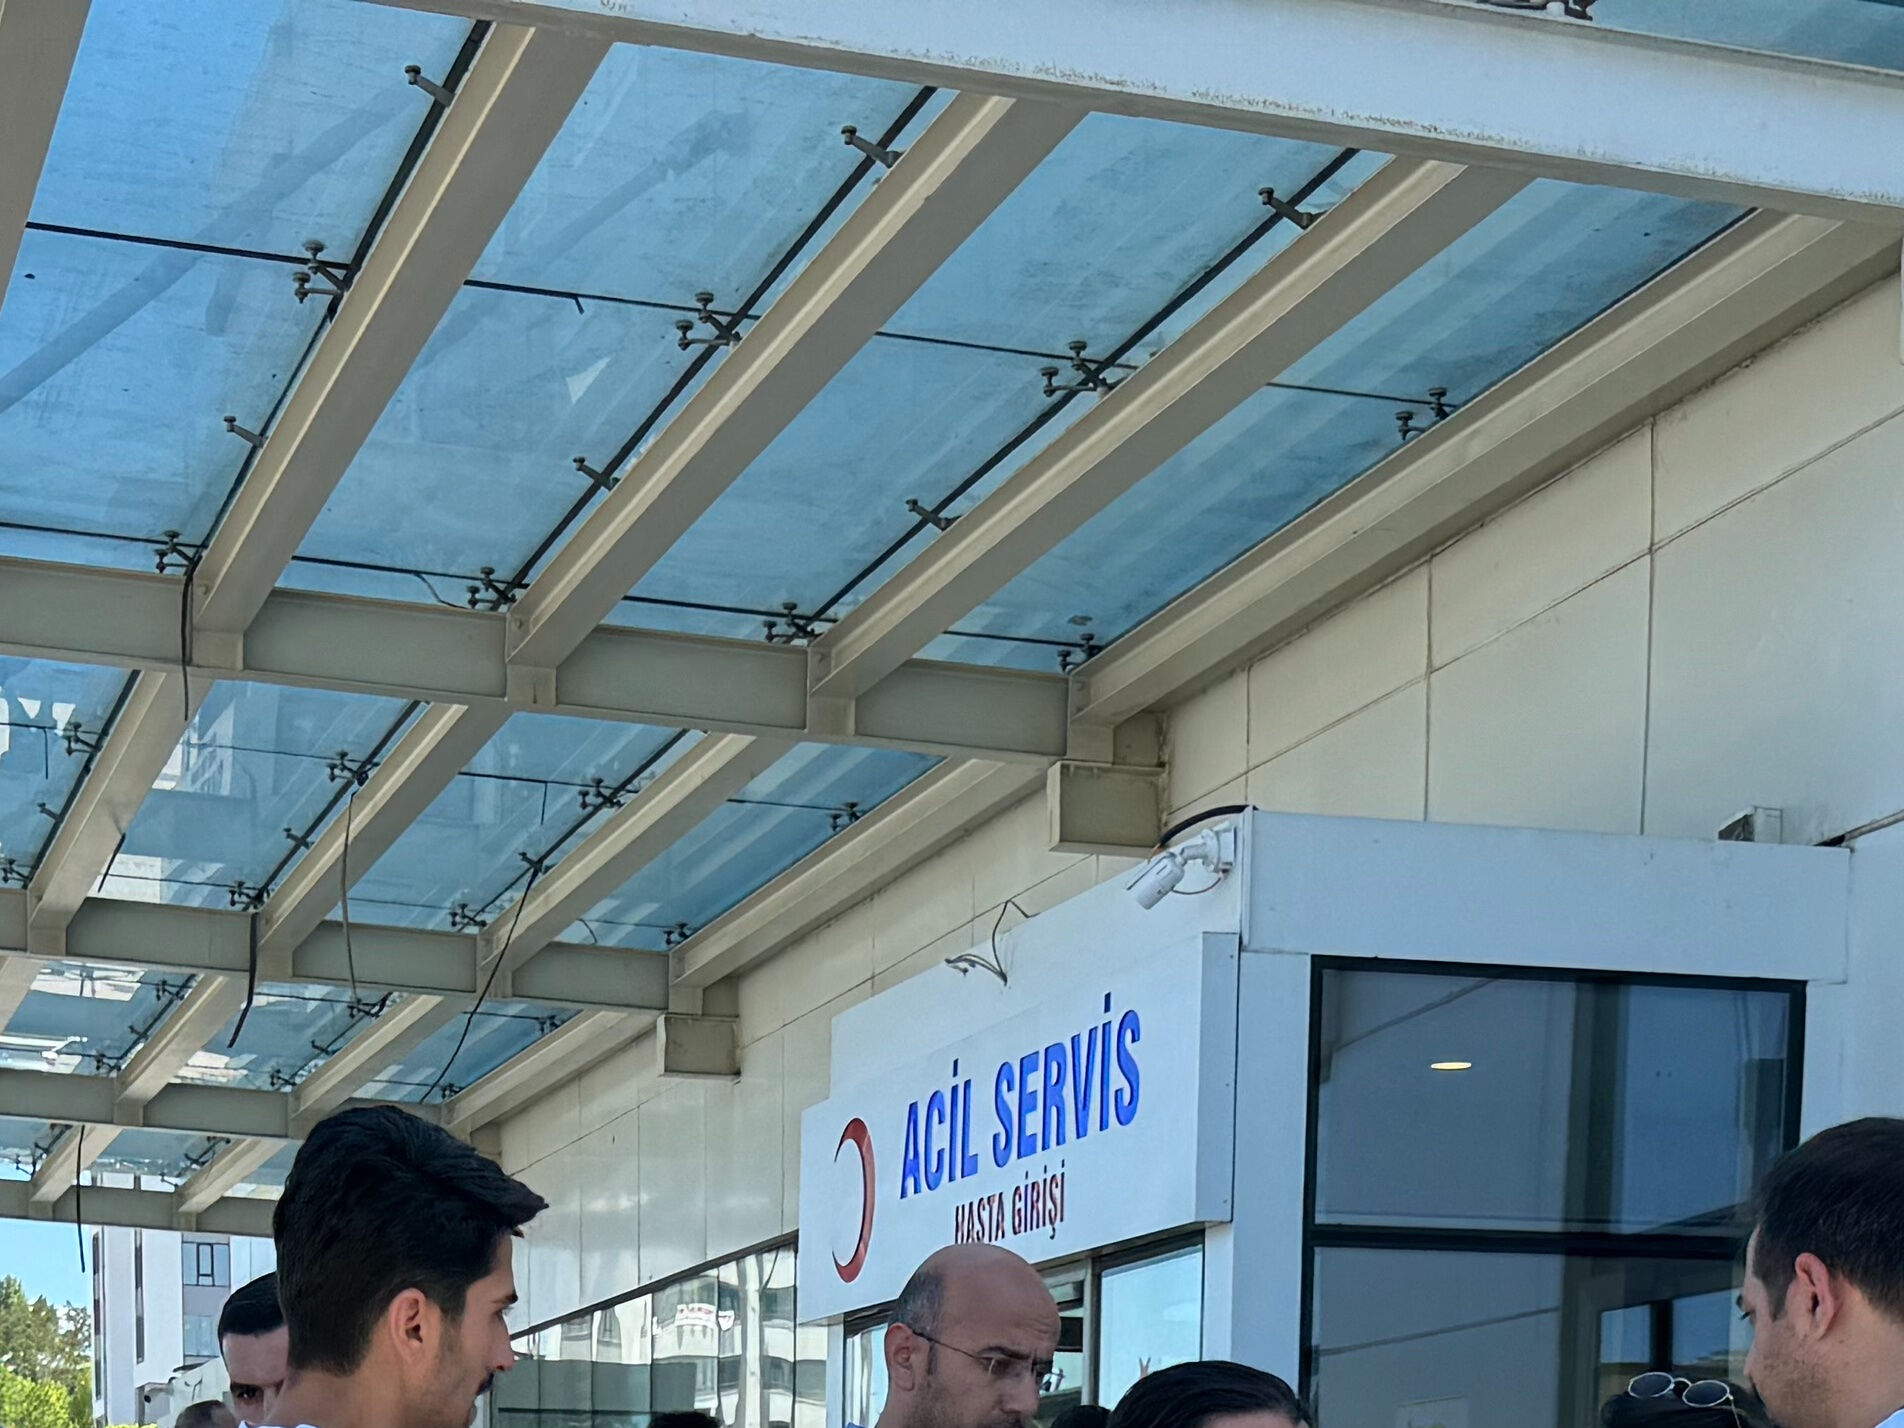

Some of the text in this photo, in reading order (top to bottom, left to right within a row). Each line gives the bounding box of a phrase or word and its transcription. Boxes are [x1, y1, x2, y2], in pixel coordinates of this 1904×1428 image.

[899, 991, 1141, 1200] ACİL SERVİS
[955, 1159, 1065, 1245] HASTA GİRİŞİ
